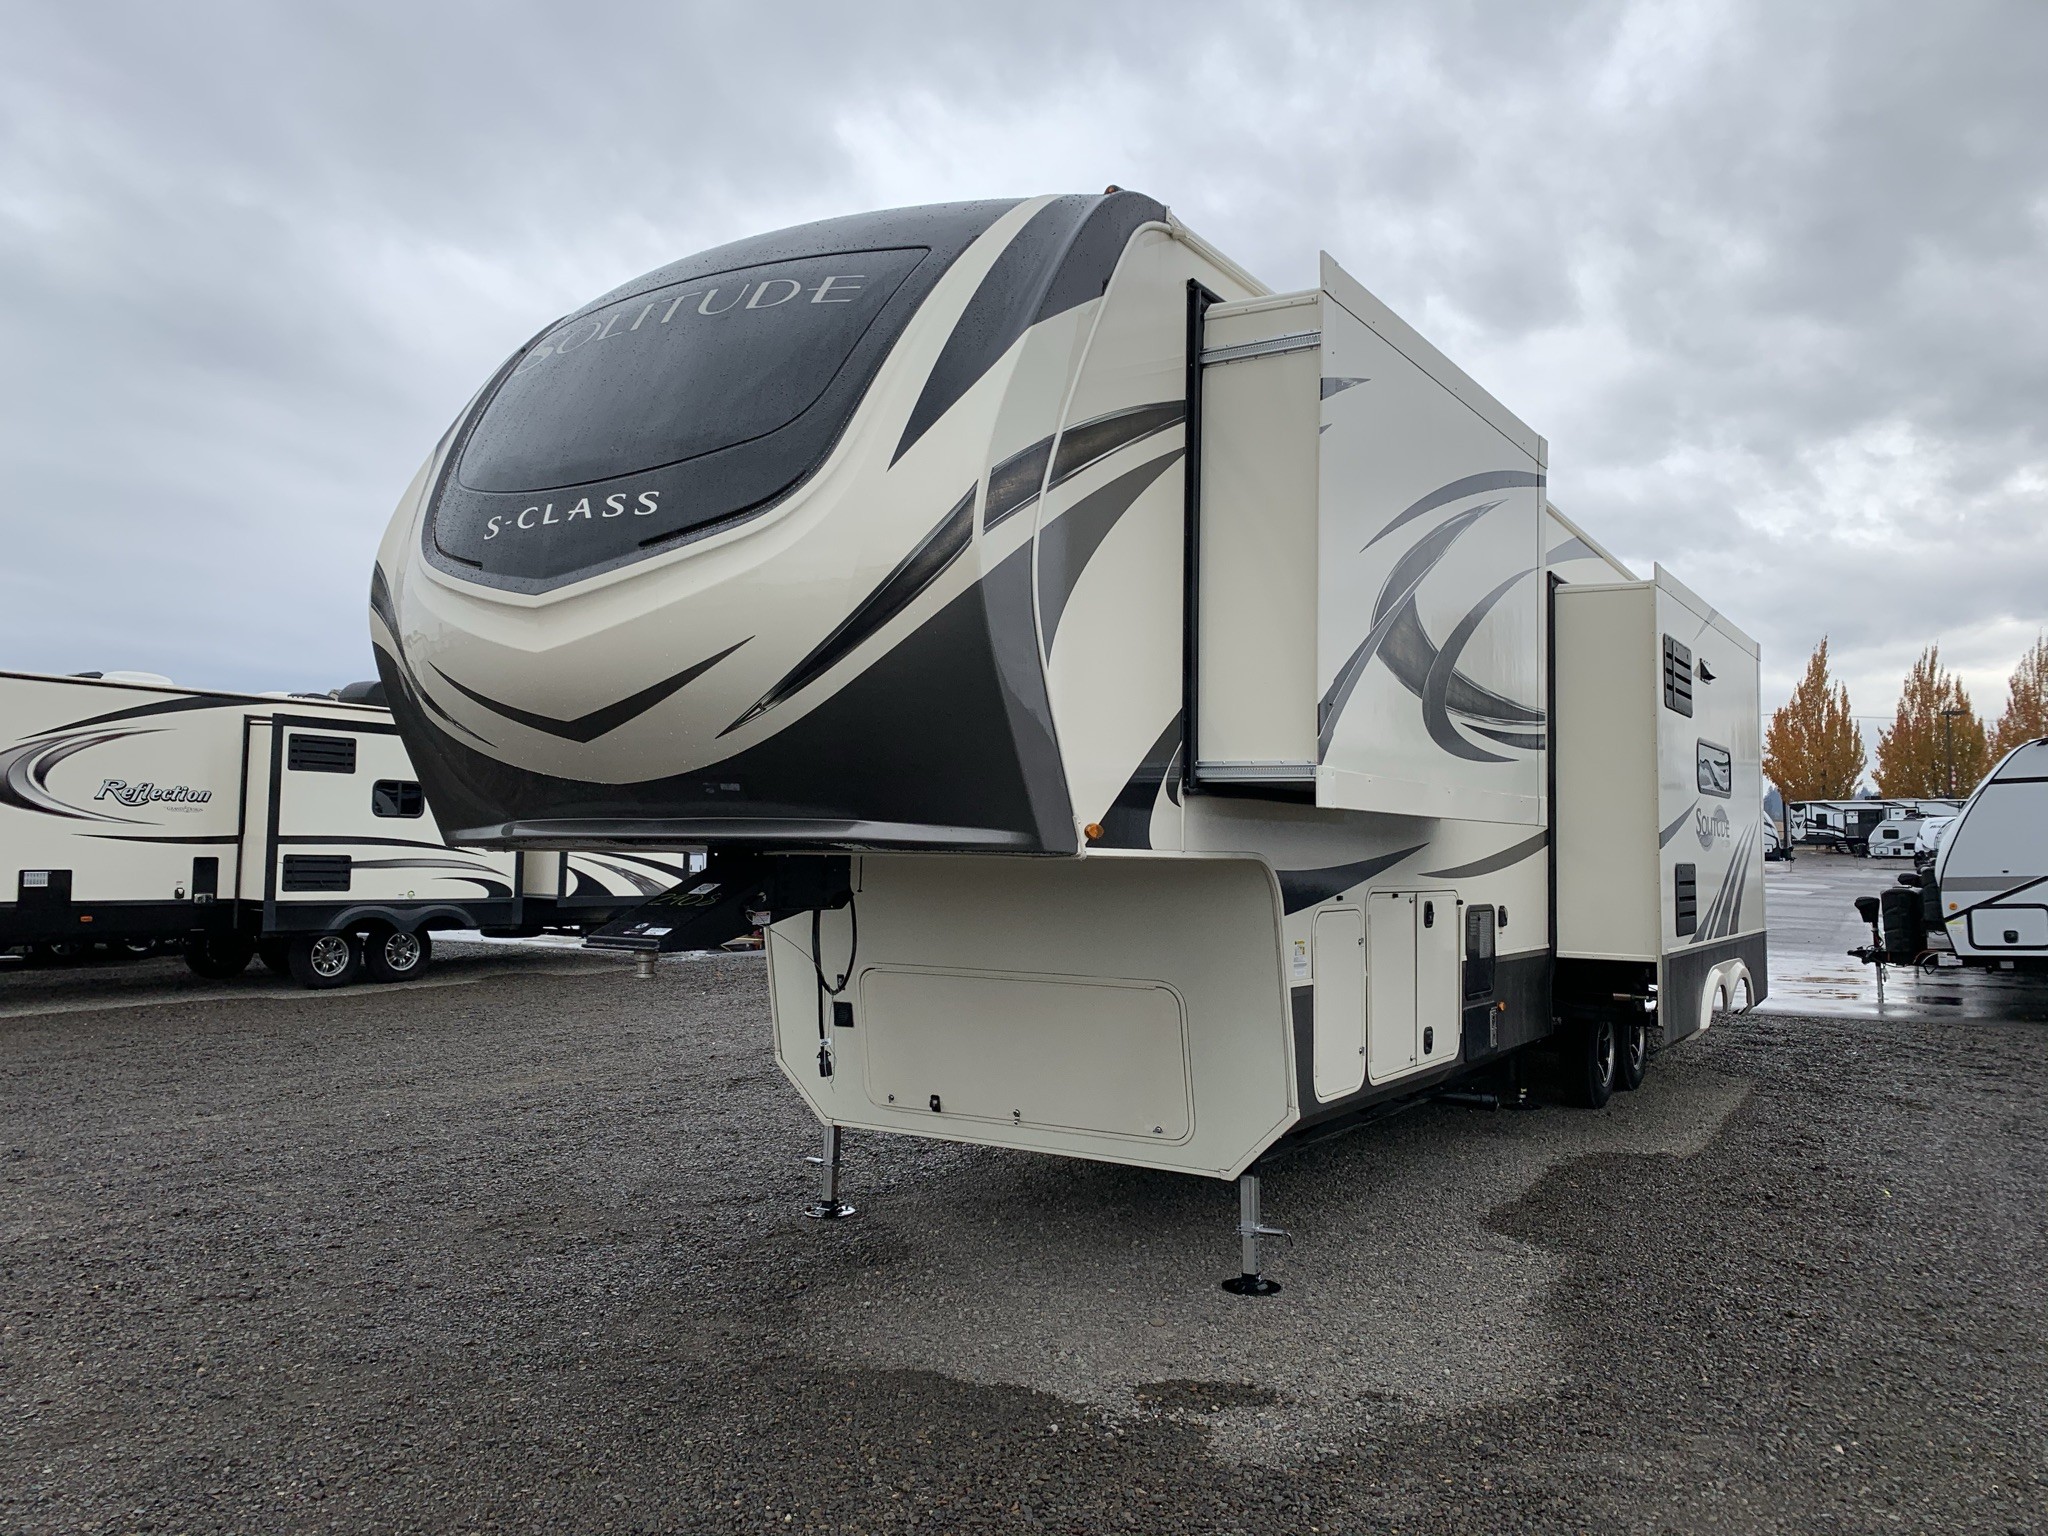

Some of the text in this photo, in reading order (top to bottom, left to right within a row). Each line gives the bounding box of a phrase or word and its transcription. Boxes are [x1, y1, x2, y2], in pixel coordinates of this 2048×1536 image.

[511, 274, 865, 377] SOLITUDE
[483, 491, 660, 540] S-CLASS
[94, 779, 212, 807] Reflection
